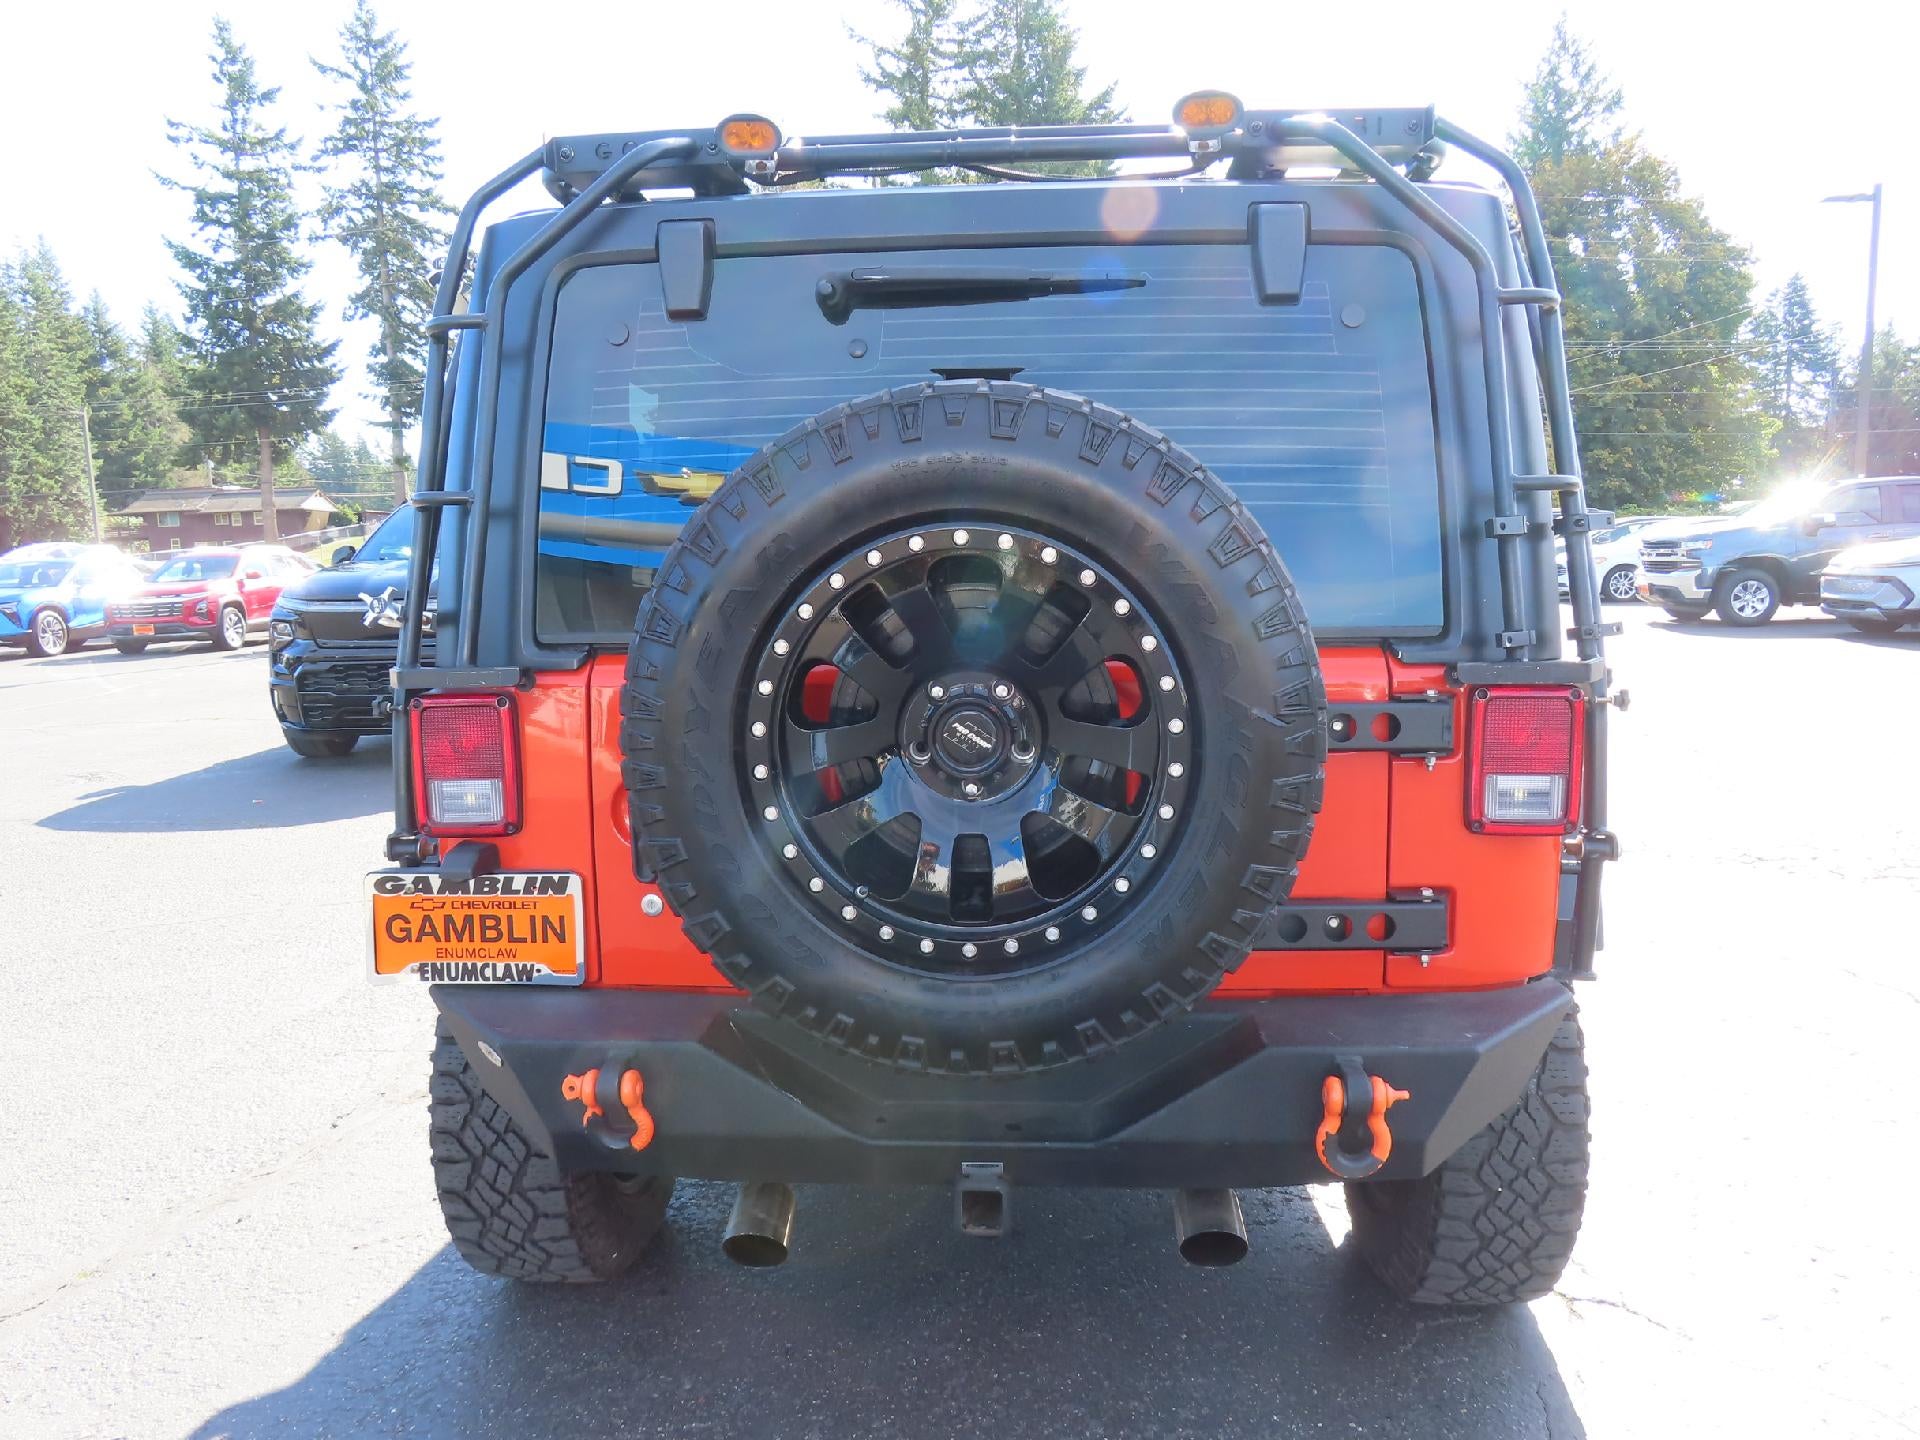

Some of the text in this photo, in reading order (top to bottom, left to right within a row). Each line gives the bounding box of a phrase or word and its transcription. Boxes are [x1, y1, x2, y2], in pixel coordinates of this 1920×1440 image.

[373, 875, 571, 896] GAMBLIN
[451, 900, 539, 910] CHEVROLET
[385, 914, 566, 944] GAMBLIN
[436, 947, 518, 959] ENUMCLAW
[418, 962, 535, 982] ENUMCLAW
